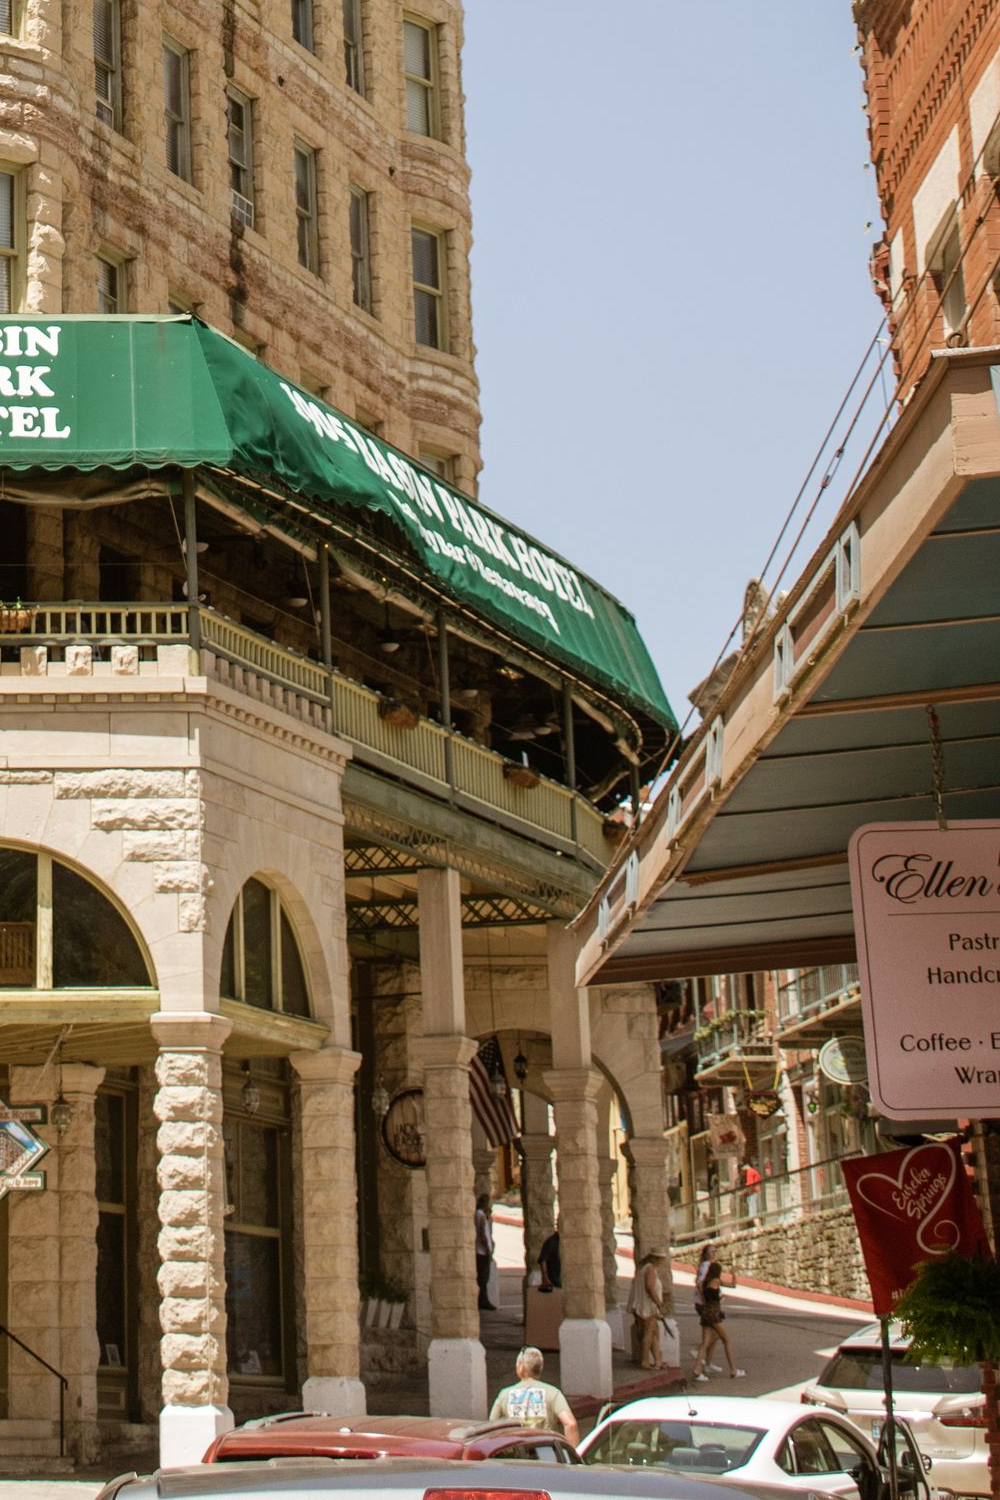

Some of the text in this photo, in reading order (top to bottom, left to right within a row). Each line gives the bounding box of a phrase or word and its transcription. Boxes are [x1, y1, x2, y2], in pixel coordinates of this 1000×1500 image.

[343, 421, 444, 522] BASIN
[434, 483, 521, 571] PARK
[507, 532, 595, 619] HOTEL
[872, 854, 994, 904] Ellen
[900, 1033, 972, 1052] Coffee
[954, 1066, 1000, 1085] Wra
[891, 1166, 932, 1211] Eureka
[906, 1173, 948, 1219] Springs
